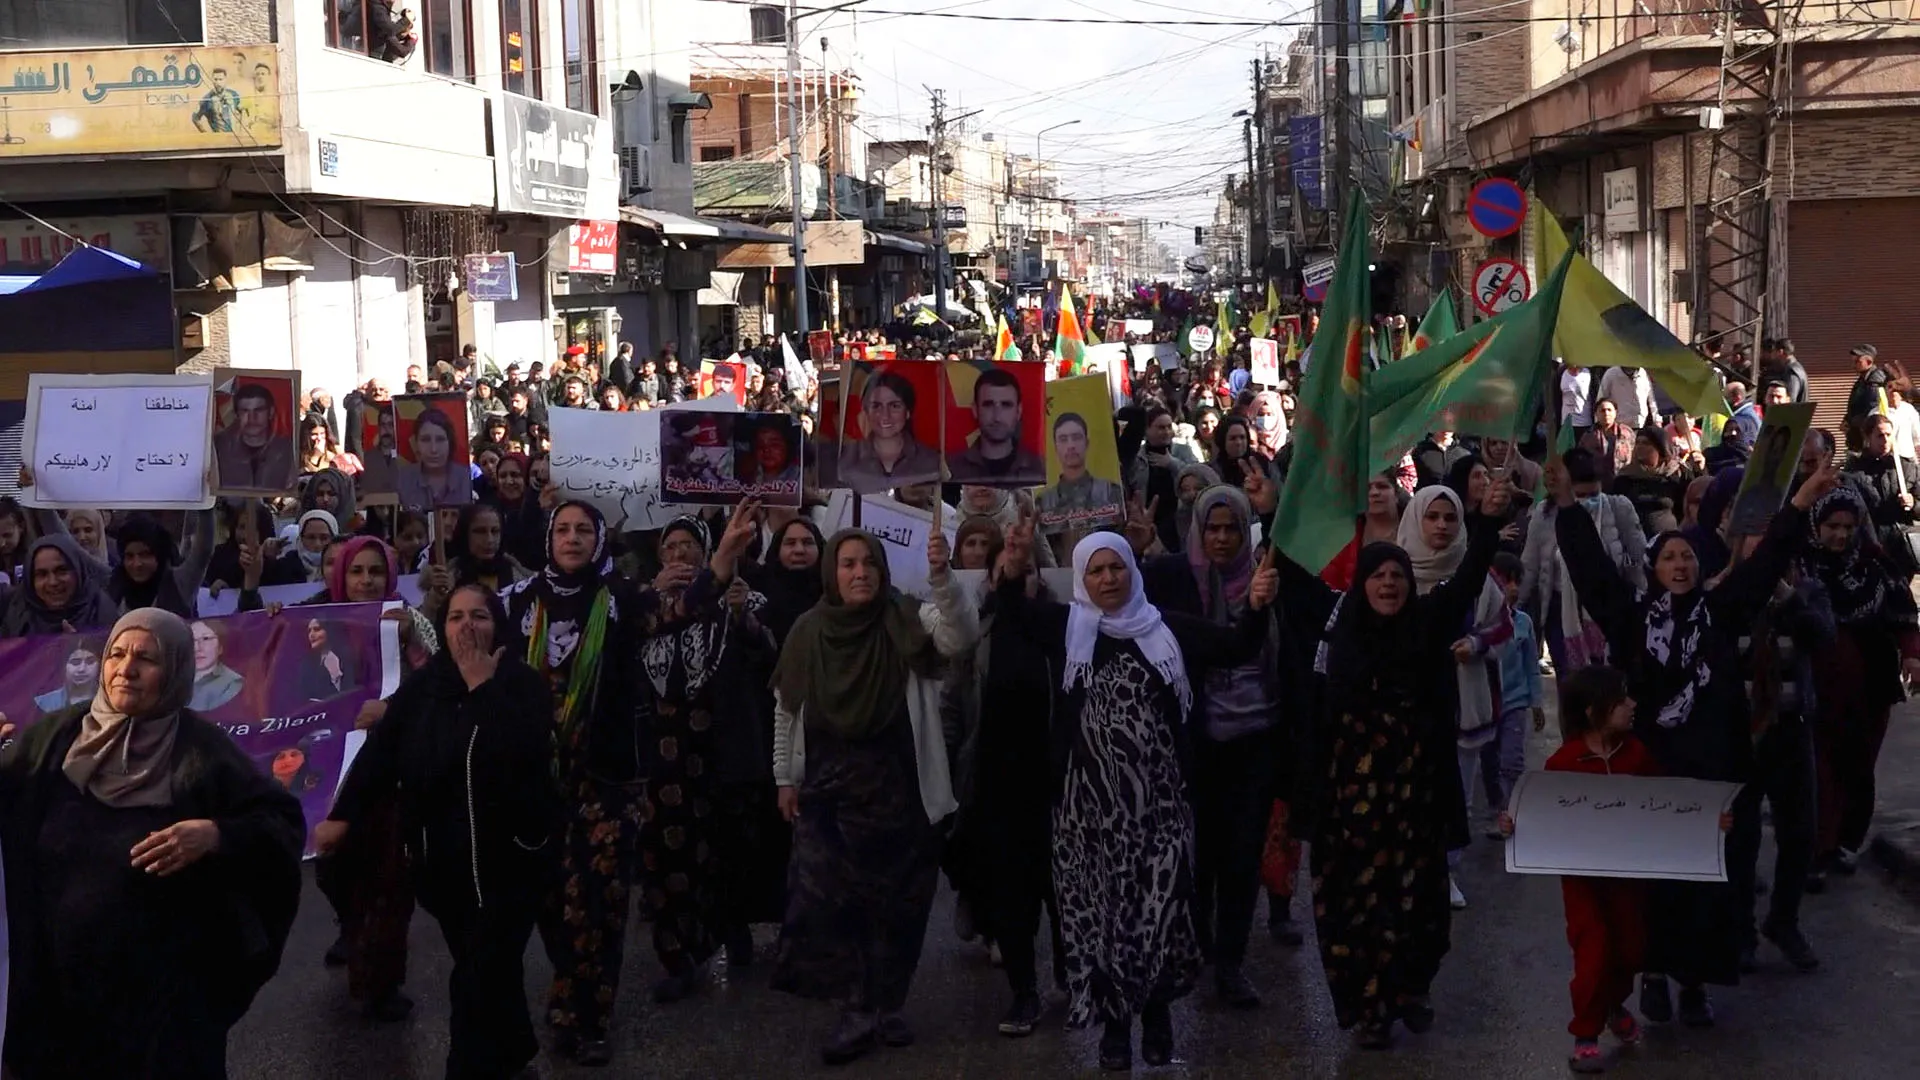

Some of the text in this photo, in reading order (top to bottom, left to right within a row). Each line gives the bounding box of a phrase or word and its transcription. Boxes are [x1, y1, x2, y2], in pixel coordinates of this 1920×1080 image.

[82, 54, 202, 104] مقهى
[1010, 227, 1019, 272] HOTEL
[145, 397, 190, 411] مناطقنا
[135, 453, 173, 472] تحتاج
[178, 453, 190, 466] لا
[785, 479, 798, 493] لا
